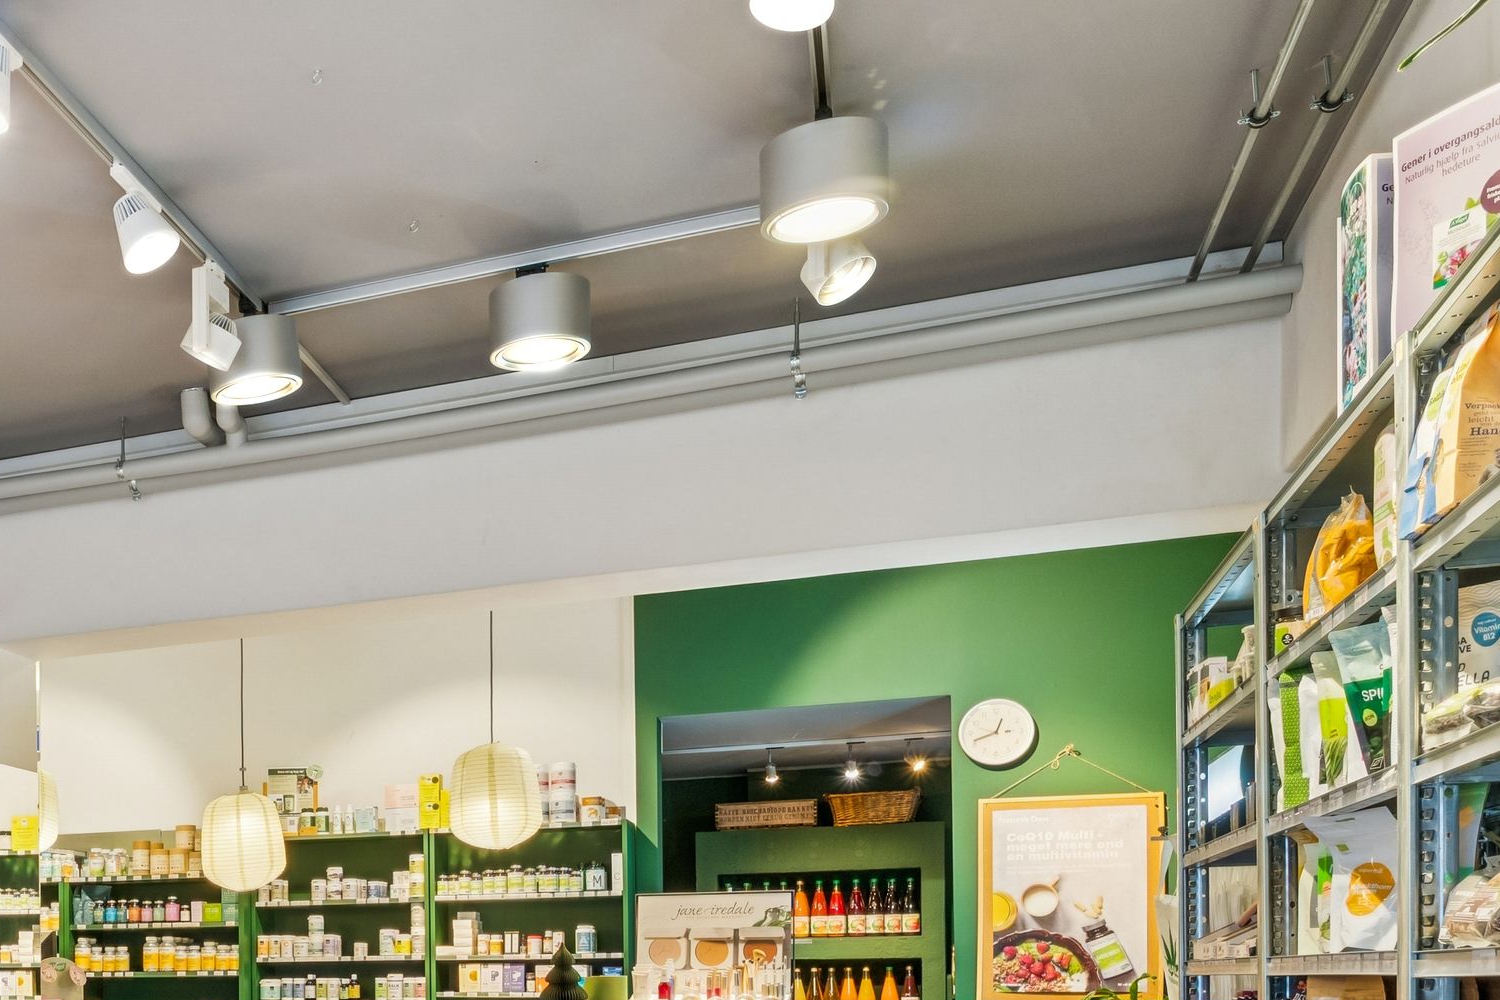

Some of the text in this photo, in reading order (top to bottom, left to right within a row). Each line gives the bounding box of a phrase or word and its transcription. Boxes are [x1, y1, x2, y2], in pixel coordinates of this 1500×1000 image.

[1401, 152, 1427, 173] Gener
[1428, 150, 1432, 159] i
[1404, 163, 1434, 184] Naturlig
[1436, 152, 1460, 170] hjælp
[1462, 143, 1474, 156] fra
[1442, 153, 1481, 177] hedeture
[1006, 830, 1094, 843] CoQ10 Multi
[1056, 841, 1089, 850] mere
[1006, 850, 1119, 861] en multivitamin
[671, 901, 755, 921] jane iredale
